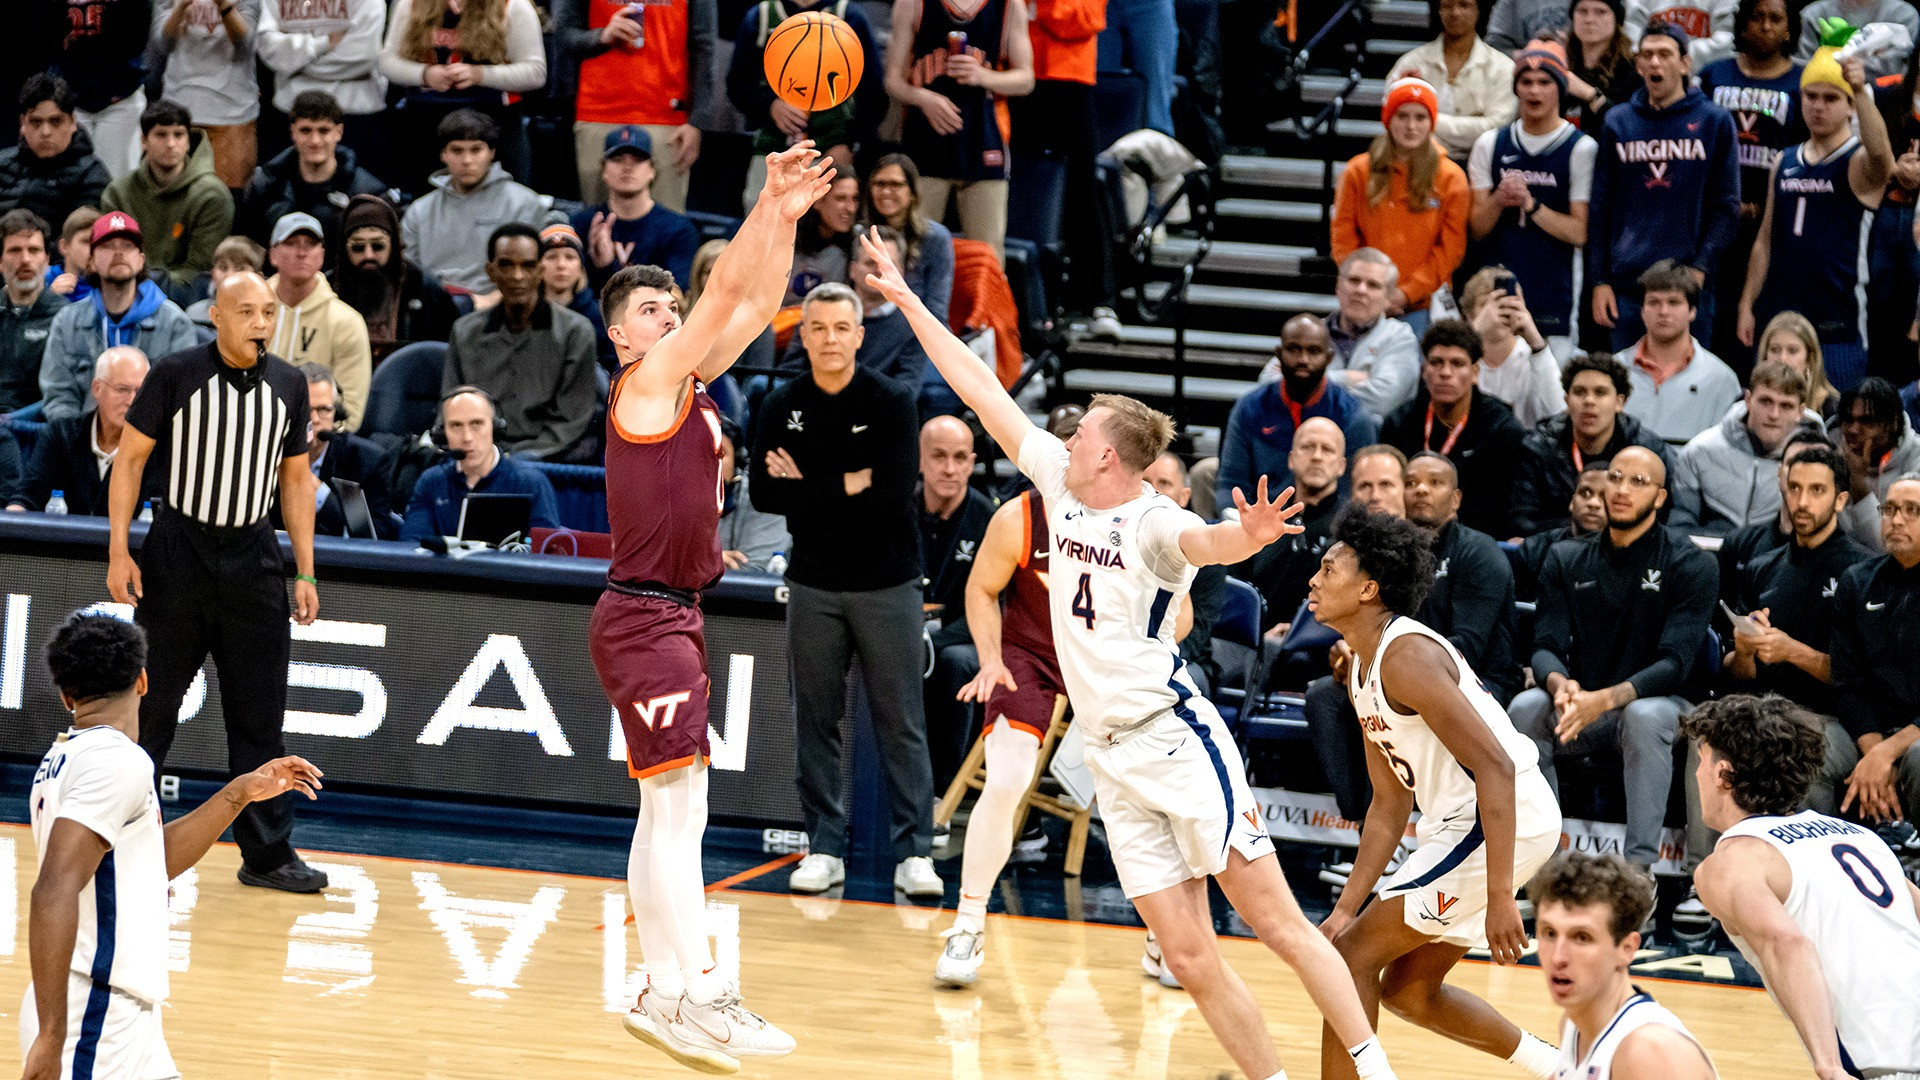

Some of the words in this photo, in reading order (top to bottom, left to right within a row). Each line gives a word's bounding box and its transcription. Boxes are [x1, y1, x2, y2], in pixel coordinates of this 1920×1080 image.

[1713, 86, 1790, 126] VIRGINIA
[1615, 139, 1707, 164] VIRGINIA
[1780, 178, 1834, 194] VIRGINIA
[1793, 196, 1807, 237] 1
[1055, 533, 1127, 571] VIRINIA
[1071, 571, 1097, 632] 4
[631, 689, 693, 733] VT
[1830, 842, 1895, 909] 0
